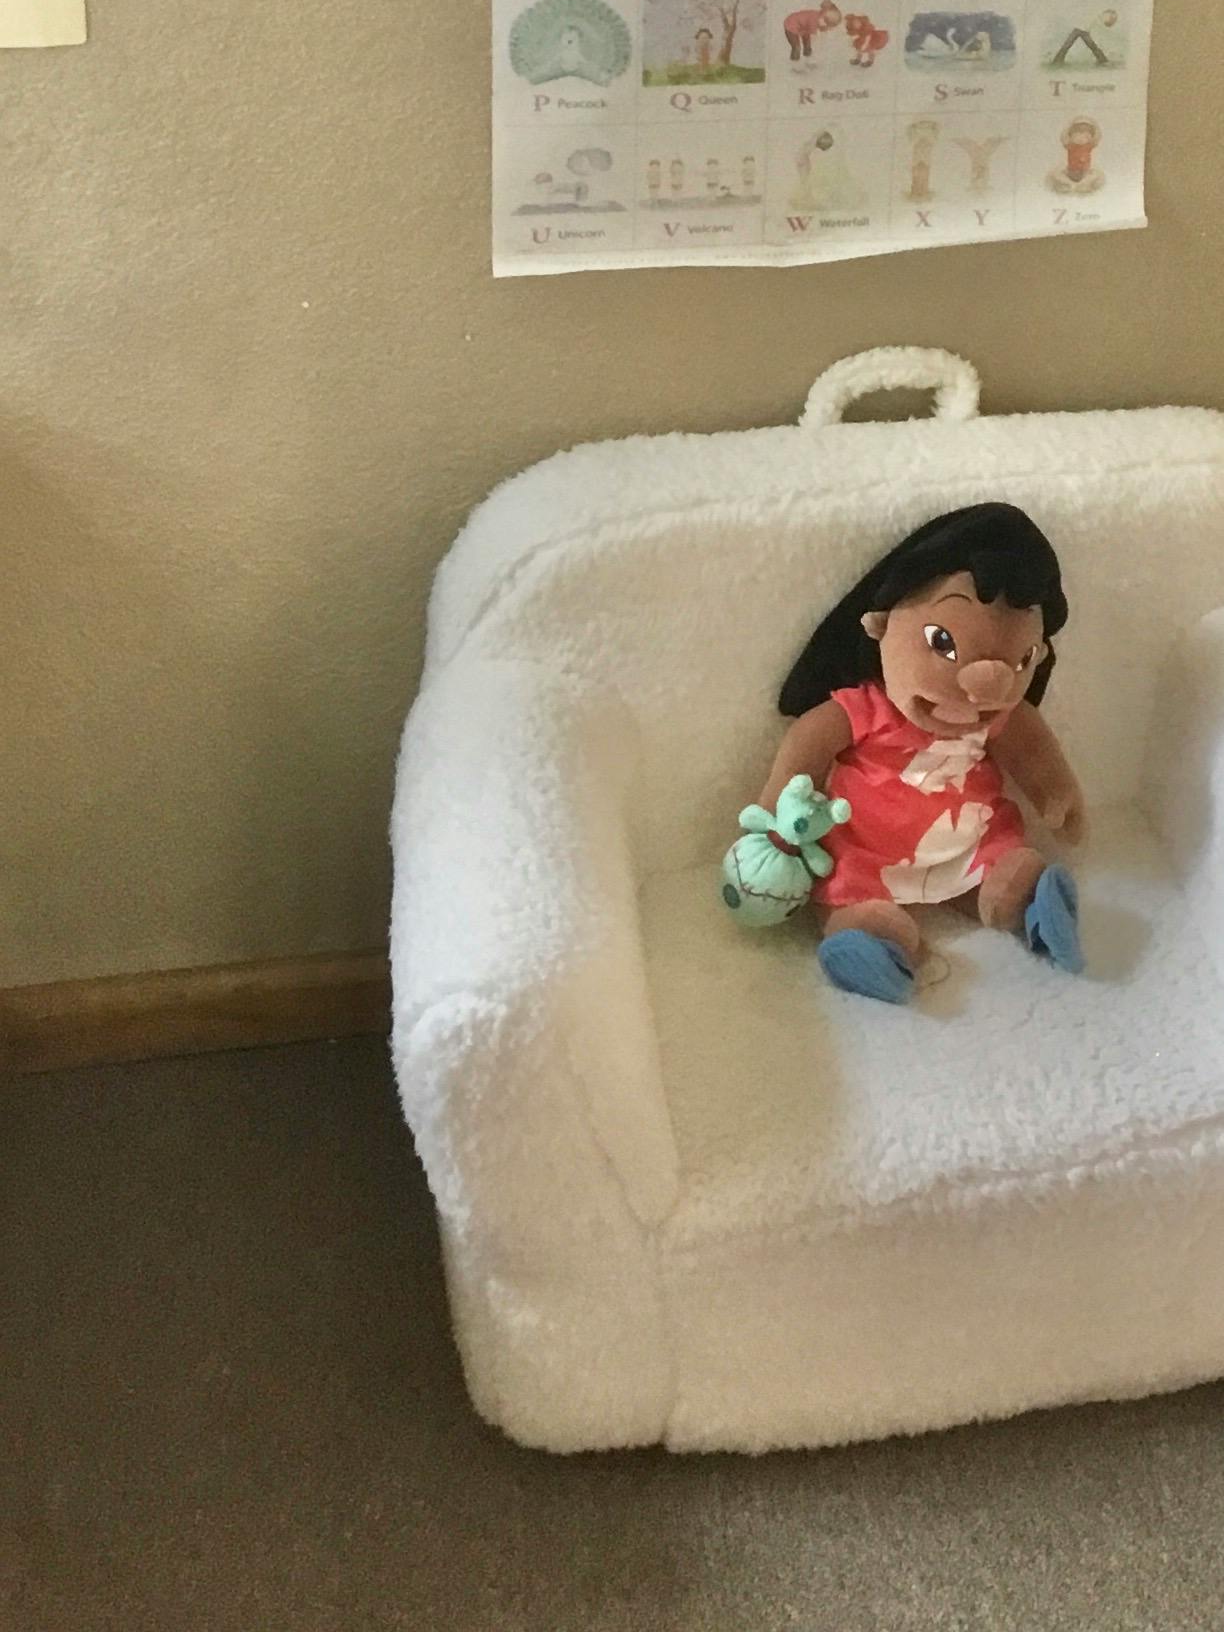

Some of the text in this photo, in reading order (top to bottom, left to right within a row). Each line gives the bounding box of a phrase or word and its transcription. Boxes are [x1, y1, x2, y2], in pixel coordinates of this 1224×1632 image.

[799, 87, 815, 105] R
[934, 83, 985, 102] S Swan
[1049, 80, 1066, 97] T
[533, 94, 608, 112] P Peacock
[670, 92, 738, 112] Q Queen
[786, 216, 869, 233] W Waterfall
[915, 209, 989, 228] X Y
[532, 227, 606, 245] U Unicorn
[664, 222, 734, 237] V Volcano
